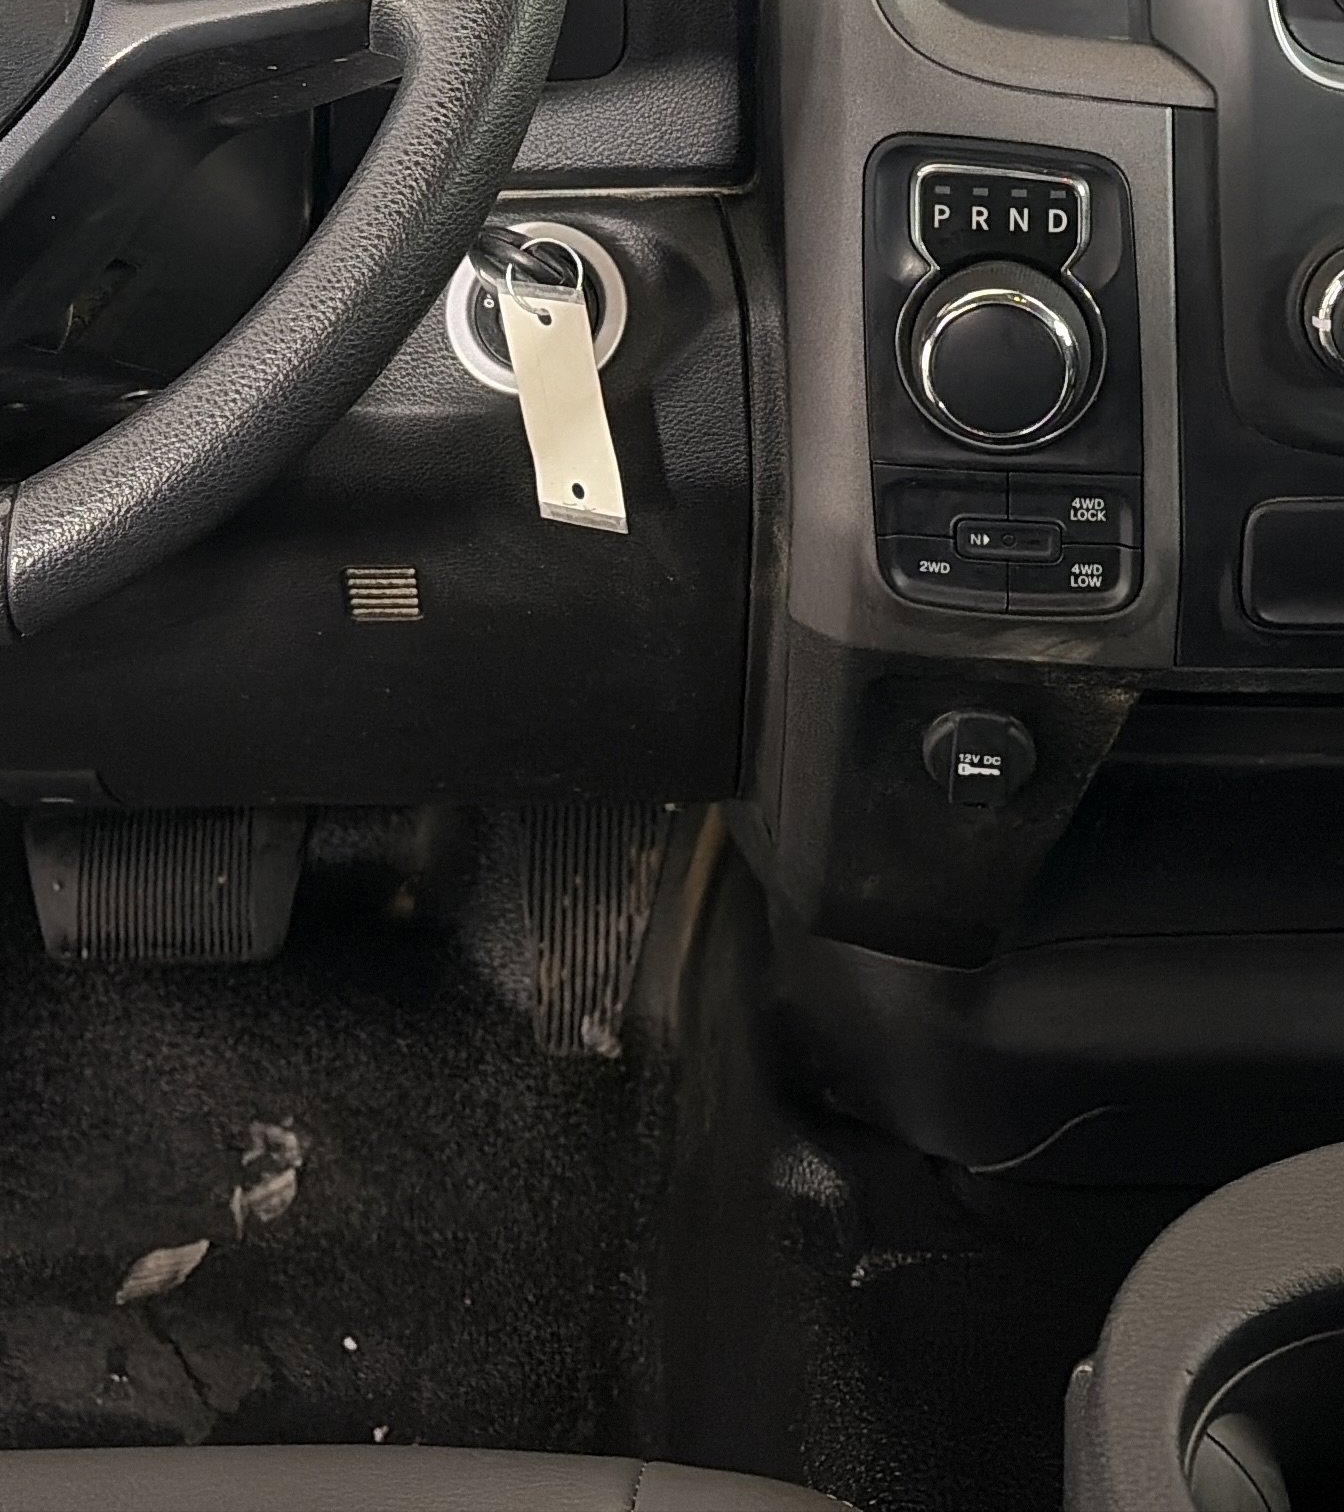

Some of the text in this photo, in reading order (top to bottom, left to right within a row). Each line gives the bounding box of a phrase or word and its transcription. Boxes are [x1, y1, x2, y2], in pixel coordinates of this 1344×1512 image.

[934, 204, 1068, 233] P R N D
[1072, 497, 1105, 510] 4WD
[1070, 509, 1106, 522] LOCK
[970, 533, 982, 546] N
[919, 560, 951, 574] 2WD
[1071, 564, 1104, 576] 4WD
[1070, 576, 1102, 588] LOW
[959, 754, 1002, 766] 12V DC
